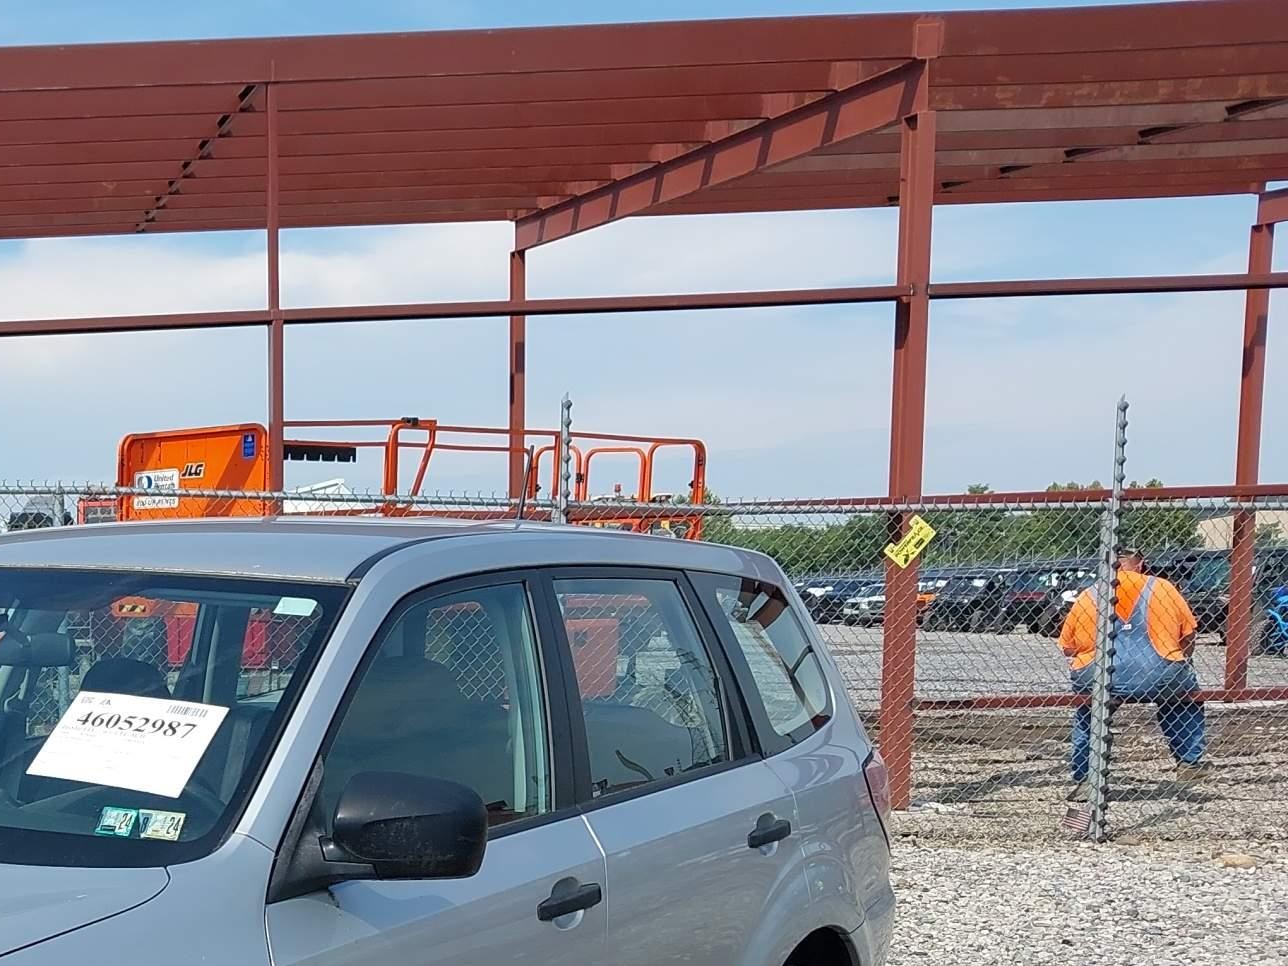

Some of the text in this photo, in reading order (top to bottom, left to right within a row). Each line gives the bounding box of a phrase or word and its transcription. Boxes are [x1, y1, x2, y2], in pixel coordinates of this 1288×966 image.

[182, 463, 204, 477] JLG
[76, 711, 198, 739] 46052987
[119, 812, 133, 830] 24
[166, 816, 182, 835] 24
